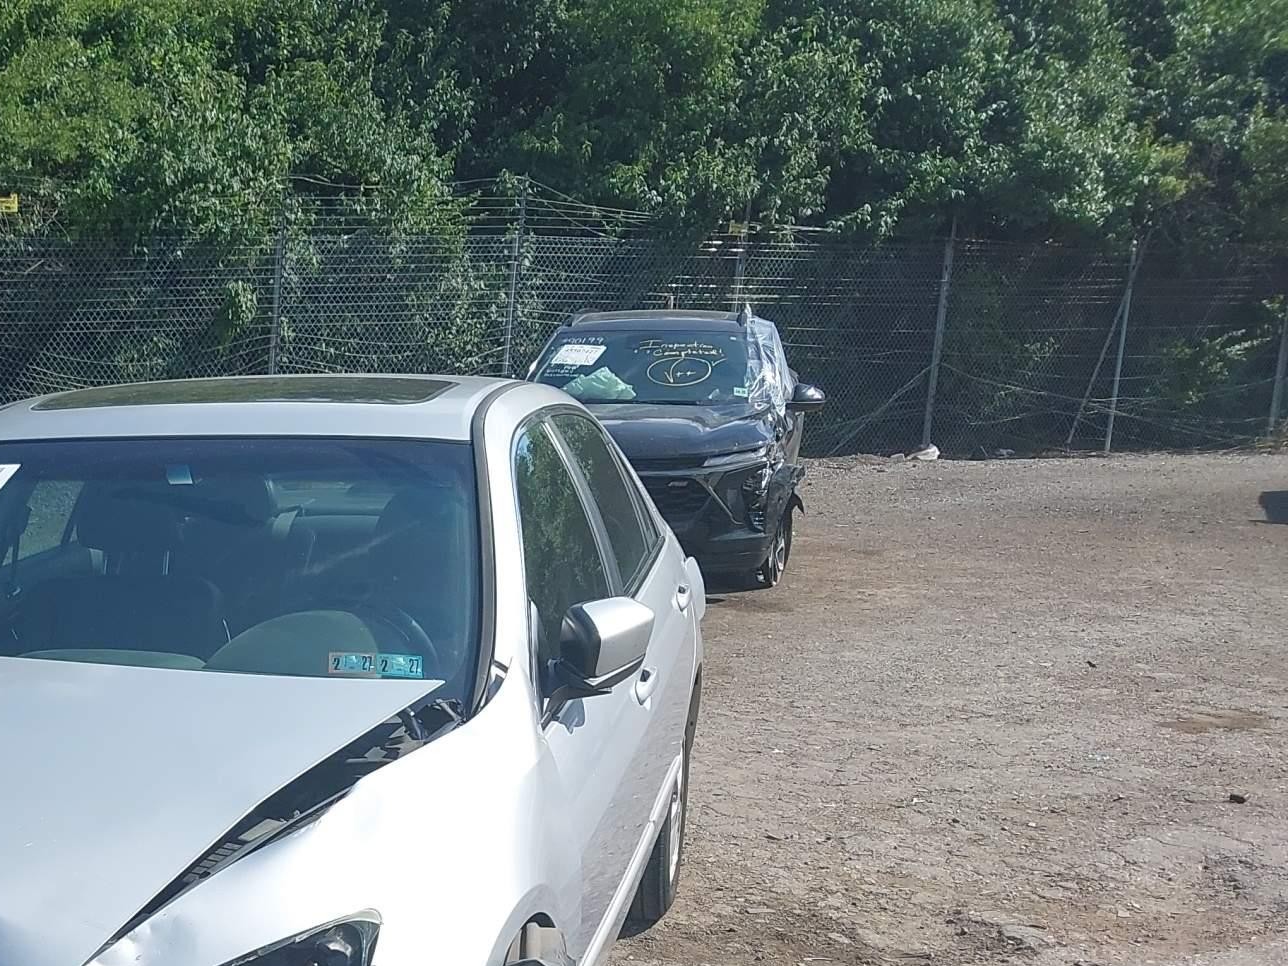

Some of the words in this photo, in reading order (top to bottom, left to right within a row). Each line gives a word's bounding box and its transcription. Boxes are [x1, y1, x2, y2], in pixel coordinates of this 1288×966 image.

[332, 657, 341, 671] 2
[361, 655, 373, 672] 27
[380, 659, 389, 673] 2
[409, 658, 420, 674] 27
